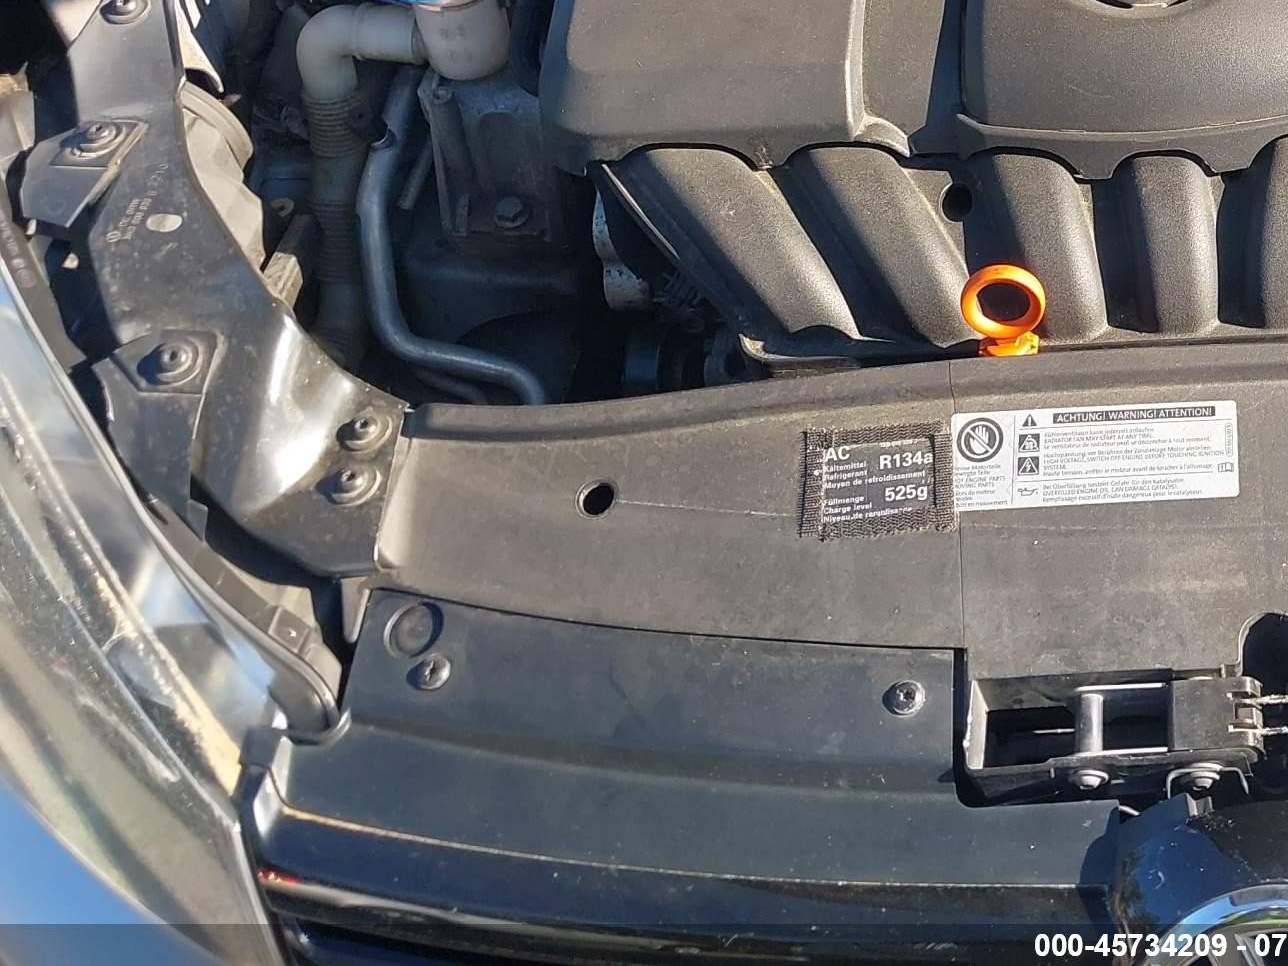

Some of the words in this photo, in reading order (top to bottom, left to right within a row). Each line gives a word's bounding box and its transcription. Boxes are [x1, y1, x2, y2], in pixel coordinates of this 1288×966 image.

[1056, 412, 1106, 423] ACHTUNG!
[1108, 410, 1157, 420] WARNING!
[1158, 407, 1212, 418] ATTENTION!
[825, 446, 850, 462] AC
[880, 450, 934, 470] R134a
[852, 476, 862, 485] de
[865, 470, 926, 484] refroidissement
[884, 484, 928, 502] 525g
[824, 504, 852, 514] Charge
[854, 502, 872, 512] level
